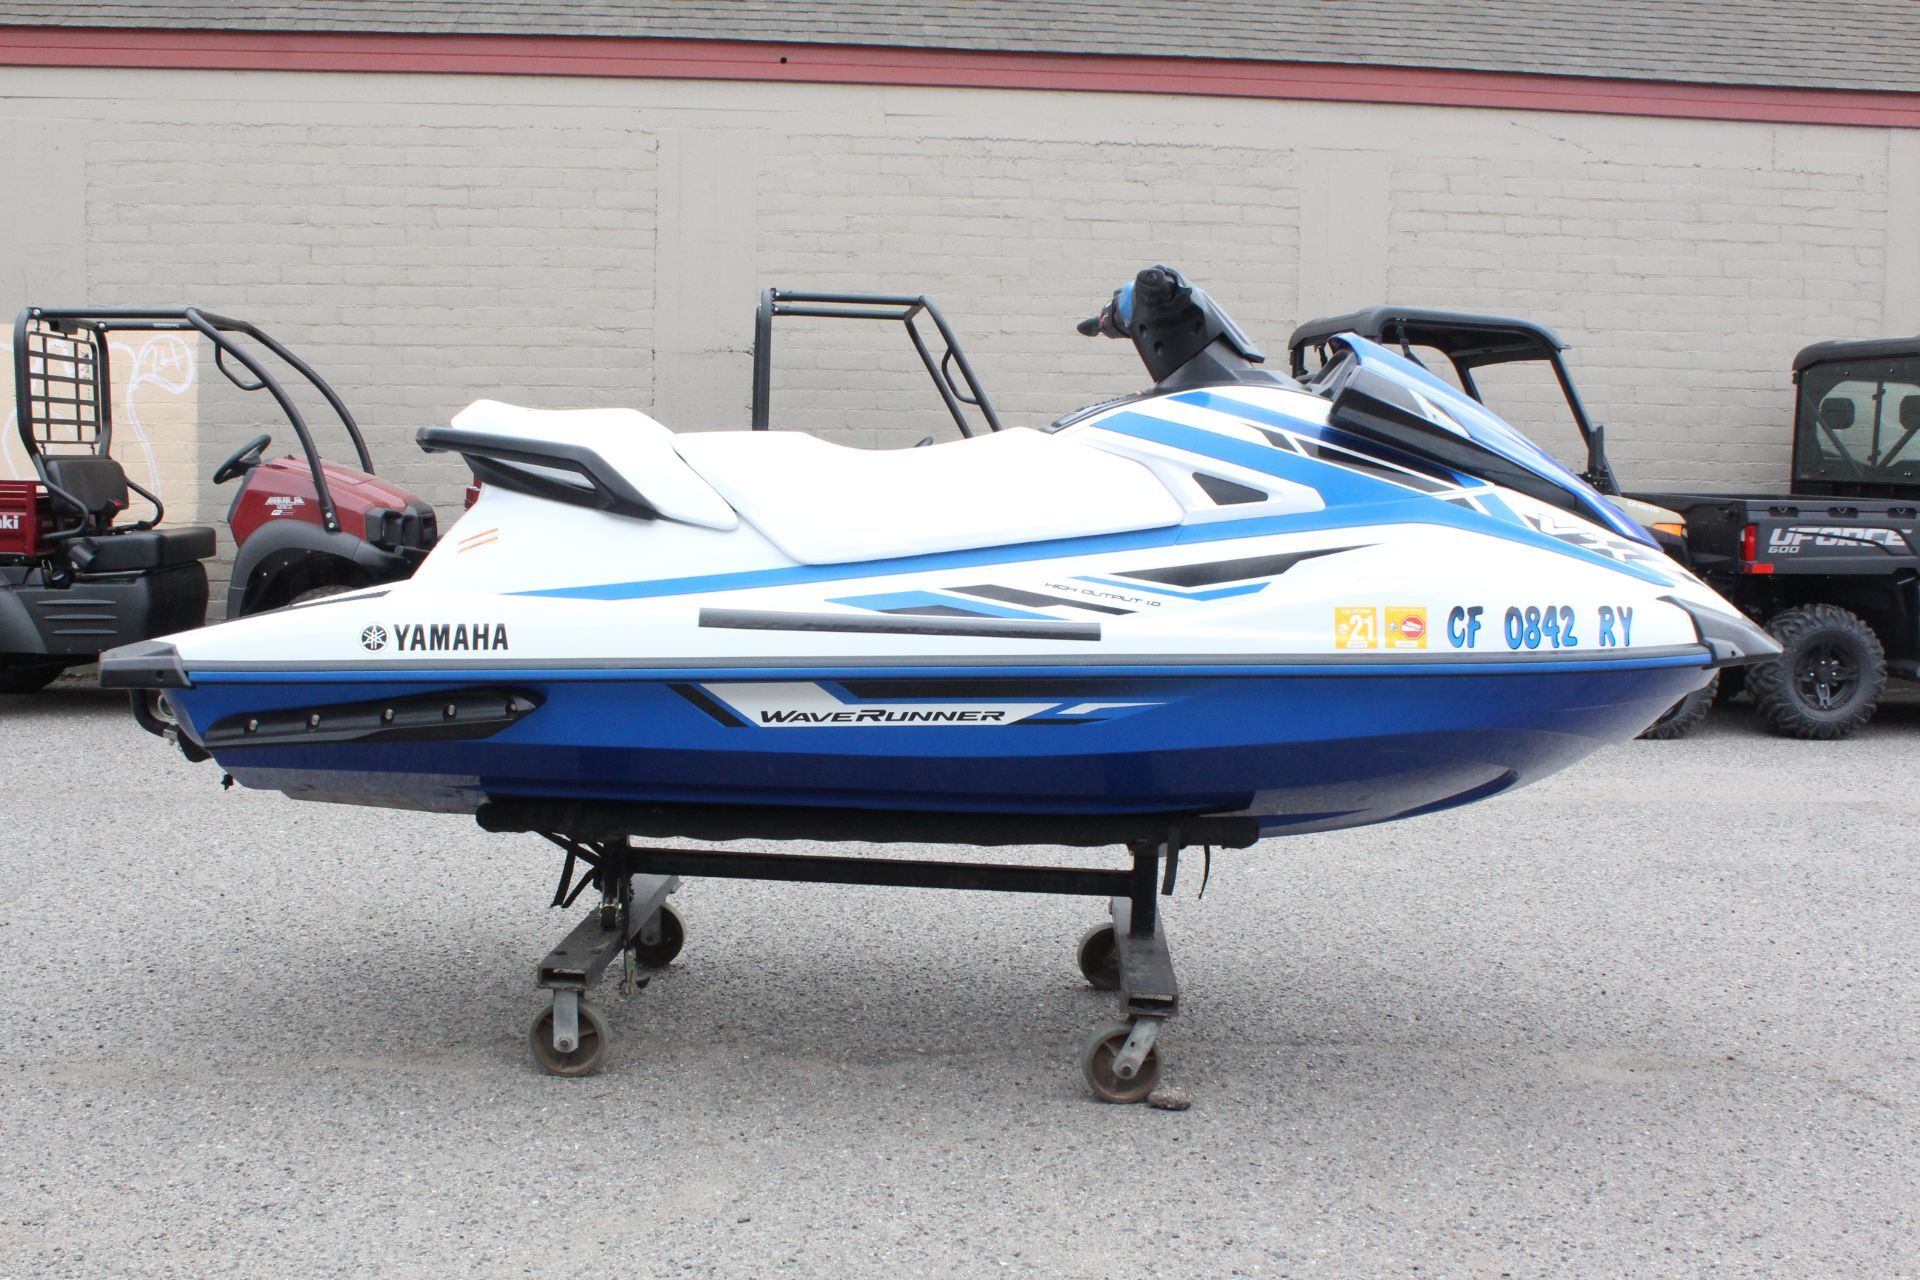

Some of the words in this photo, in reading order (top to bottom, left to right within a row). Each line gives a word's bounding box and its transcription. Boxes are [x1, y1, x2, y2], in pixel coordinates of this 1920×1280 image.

[0, 513, 19, 529] ki
[1769, 527, 1912, 547] UFORCE
[1767, 546, 1800, 554] 600
[1045, 582, 1078, 592] HIGH
[1081, 589, 1143, 602] OUTPUT
[394, 623, 509, 651] YAMAHA
[1350, 614, 1374, 641] 21
[1447, 605, 1483, 648] CF
[1504, 605, 1578, 650] 0842
[1598, 605, 1633, 647] RY
